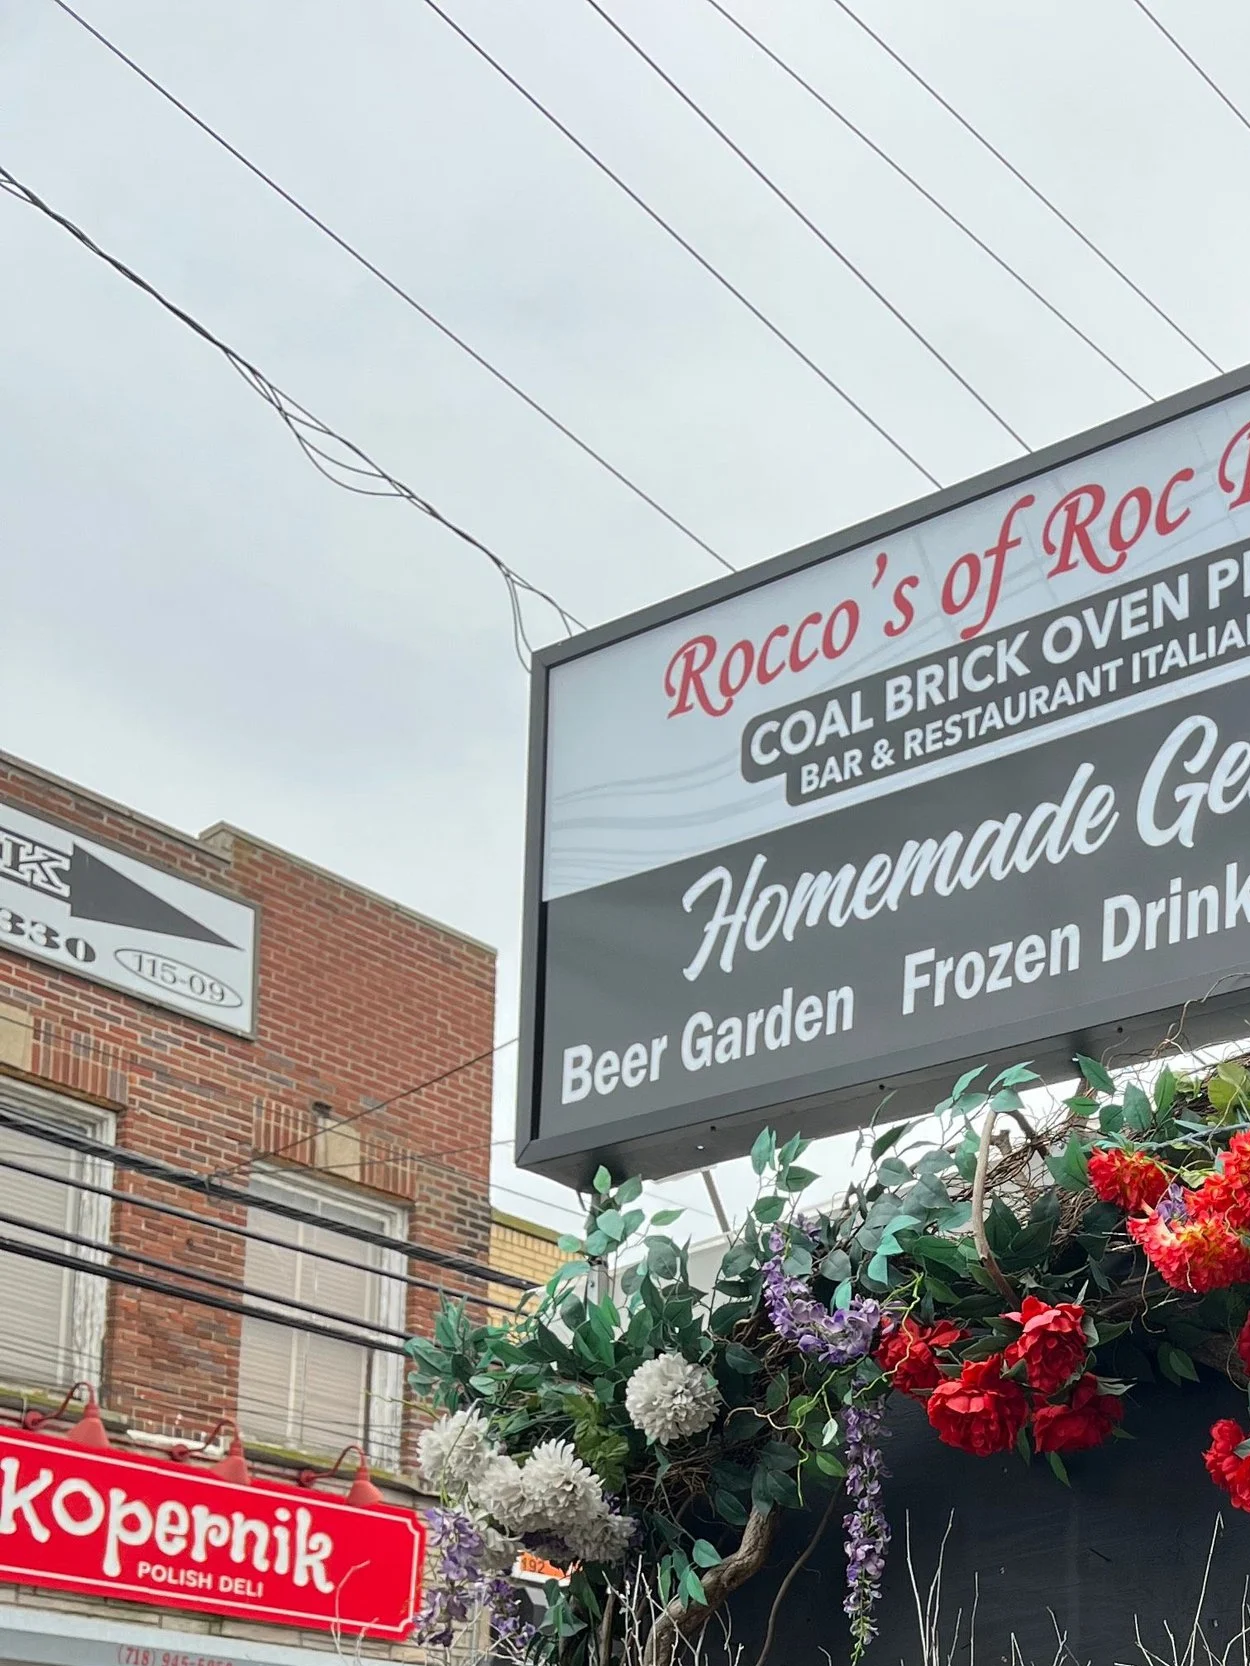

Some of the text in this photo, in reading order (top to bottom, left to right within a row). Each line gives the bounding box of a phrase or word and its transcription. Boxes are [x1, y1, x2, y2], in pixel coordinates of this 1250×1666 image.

[666, 556, 918, 716] Rocco's
[943, 494, 1034, 640] of
[1042, 467, 1195, 580] Roc
[750, 690, 874, 766] COAL
[885, 630, 1031, 722] BRICK
[1042, 573, 1189, 664] OVEN
[800, 748, 863, 795] BAR
[871, 738, 896, 770] &
[904, 658, 1124, 761] RESTAURANT
[682, 762, 1119, 982] Homemade
[133, 953, 225, 1004] 115-09
[902, 922, 1081, 1016] Frozen
[561, 984, 855, 1105] Beer Garden
[0, 1456, 335, 1594] Kopernik
[137, 1560, 264, 1599] POLISH DELI
